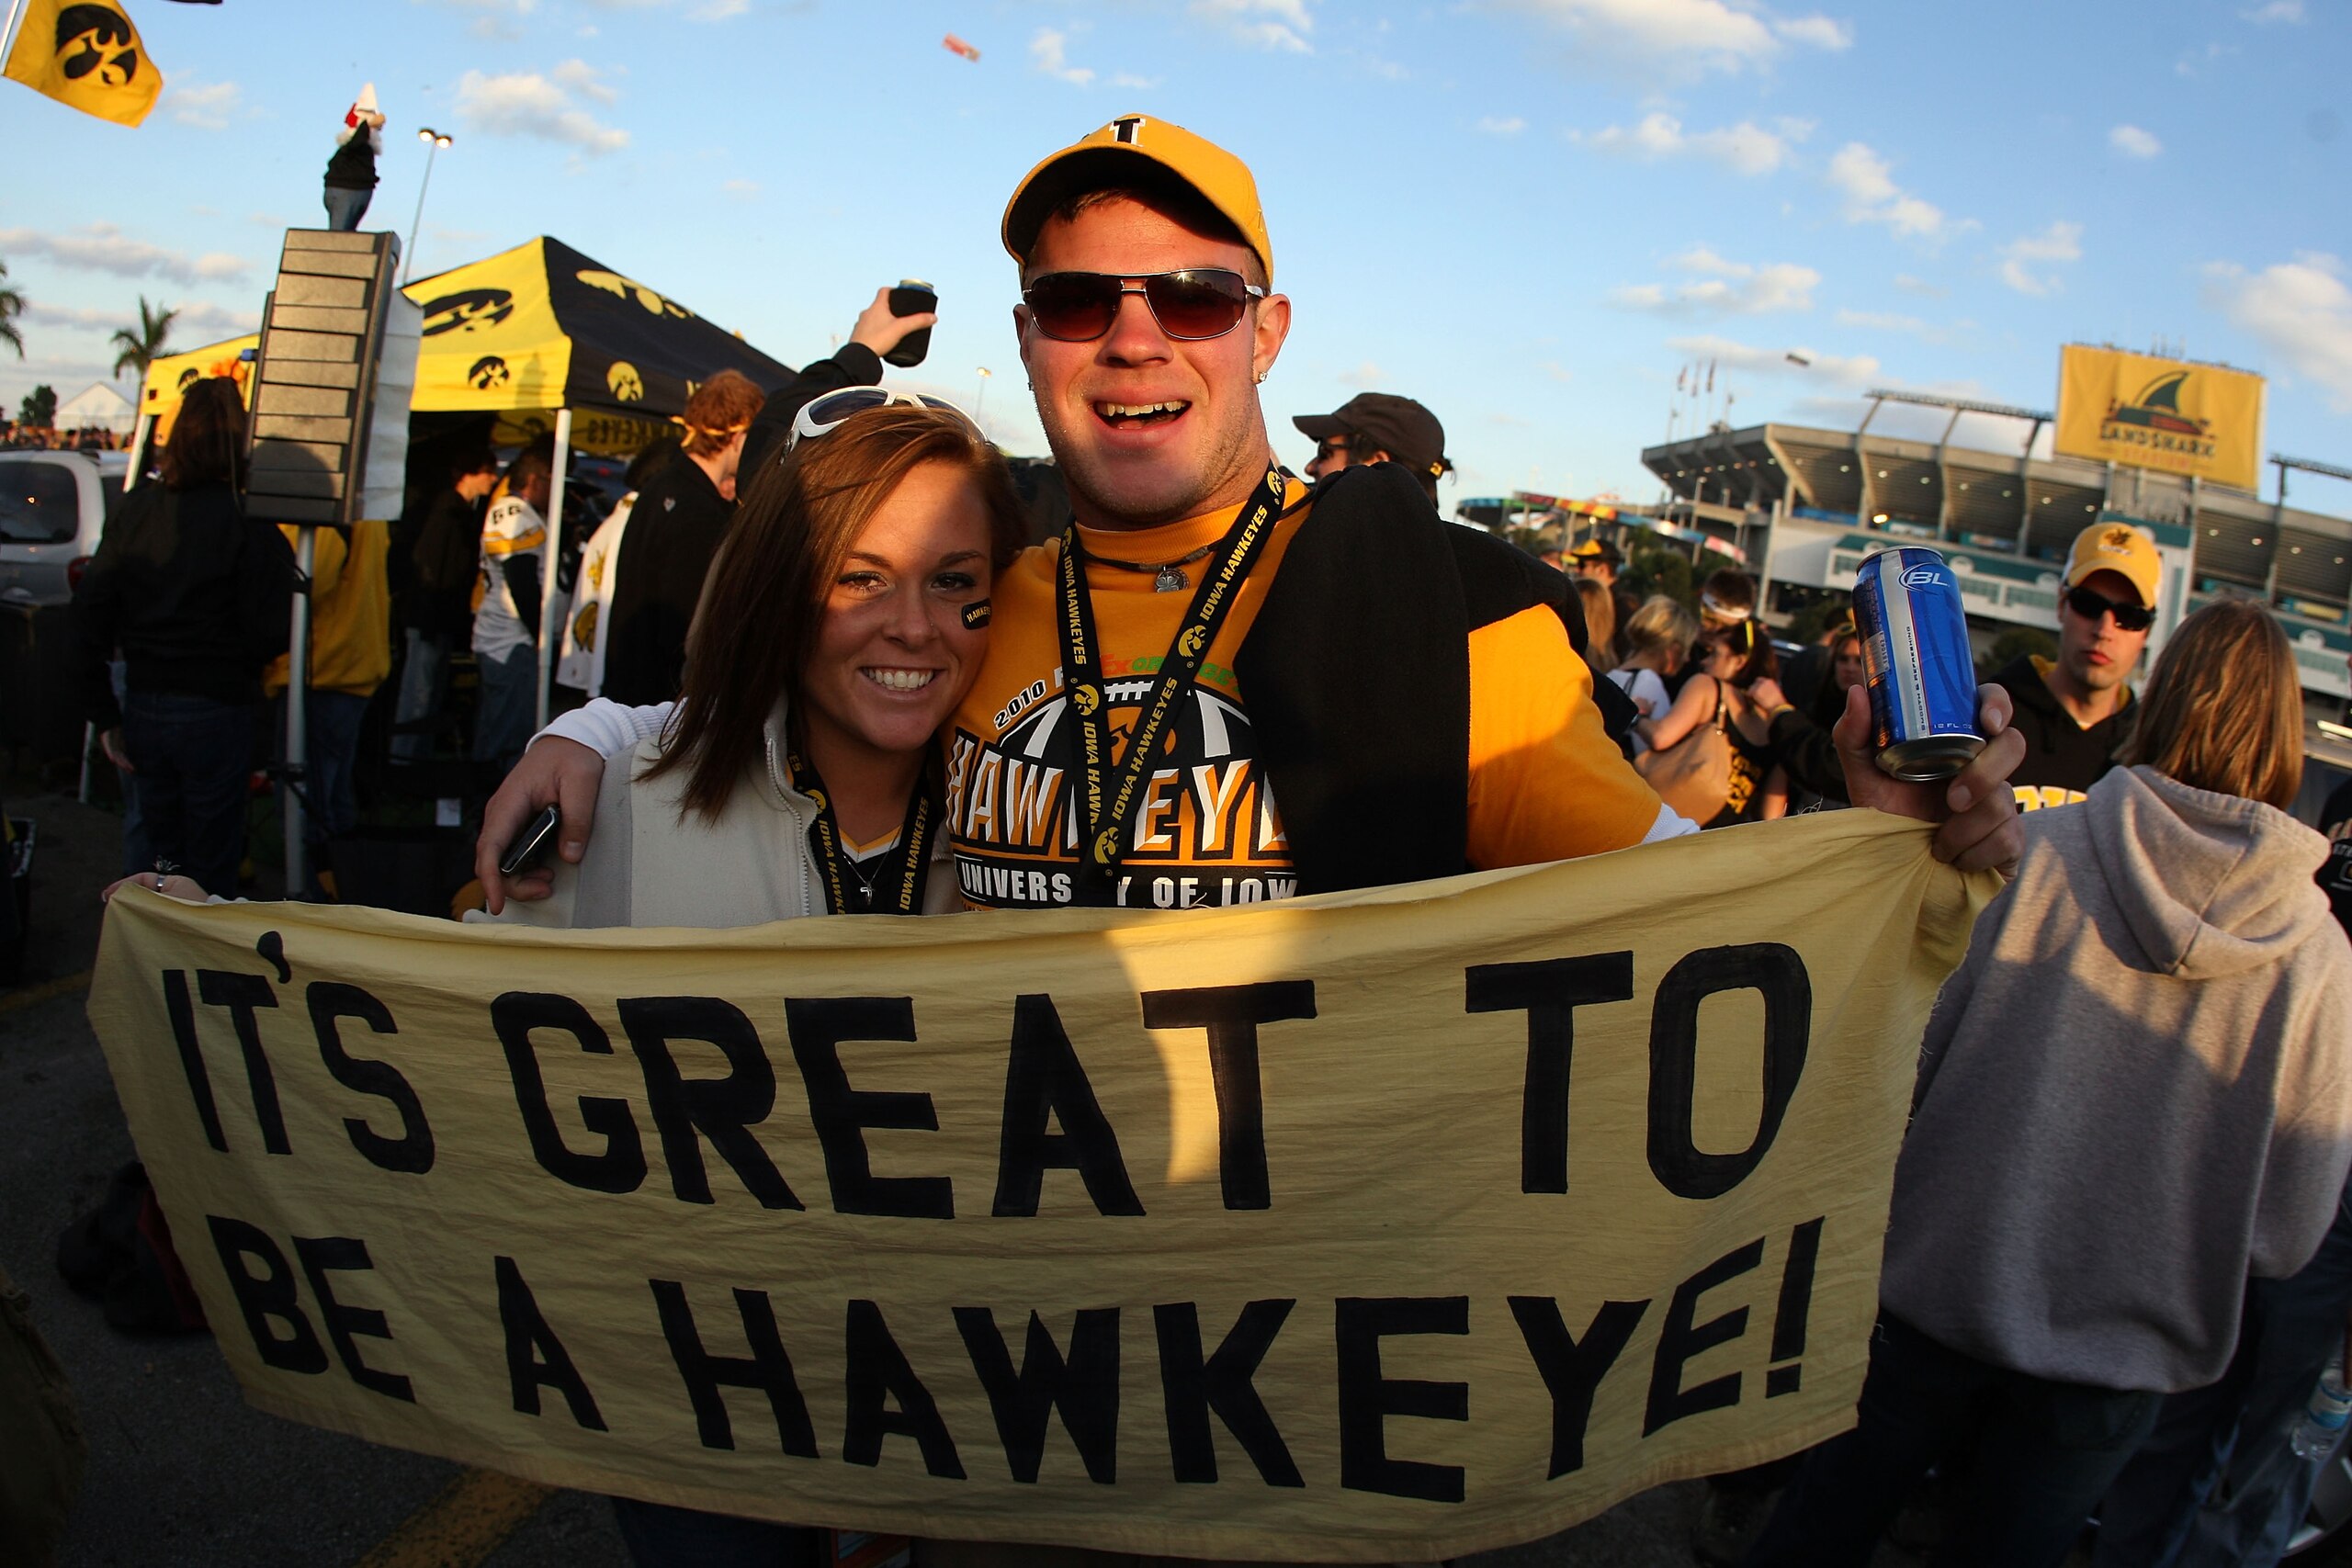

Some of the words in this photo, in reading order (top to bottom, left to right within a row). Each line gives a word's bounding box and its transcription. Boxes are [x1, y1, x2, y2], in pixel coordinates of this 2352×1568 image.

[1064, 555, 1076, 589] IOWA
[1199, 582, 1227, 622] IOWA
[1221, 504, 1268, 581] HAWKEYES
[1067, 589, 1087, 665] HAWKEYES
[1905, 626, 1920, 682] REFRESHING
[993, 679, 1047, 731] 2010
[1132, 656, 1235, 686] ORGE
[1915, 693, 1926, 731] SMOOTH
[1082, 721, 1100, 765] IOWA
[1112, 774, 1136, 822] IOWA
[1130, 677, 1178, 773] HAWKEYES
[818, 818, 834, 858] IOWA
[906, 796, 930, 870] HAWKEYES
[899, 871, 915, 911] IOWA
[961, 861, 1133, 908] UNIVERSY
[1152, 876, 1199, 908] OF
[1221, 876, 1298, 908] IOW
[162, 931, 436, 1176] IT'S
[490, 979, 1318, 1220] GREAT
[1464, 942, 1813, 1201] TO
[204, 1213, 418, 1404] BE
[493, 1254, 610, 1433] A
[647, 1215, 1826, 1504] HAWKEYE!
